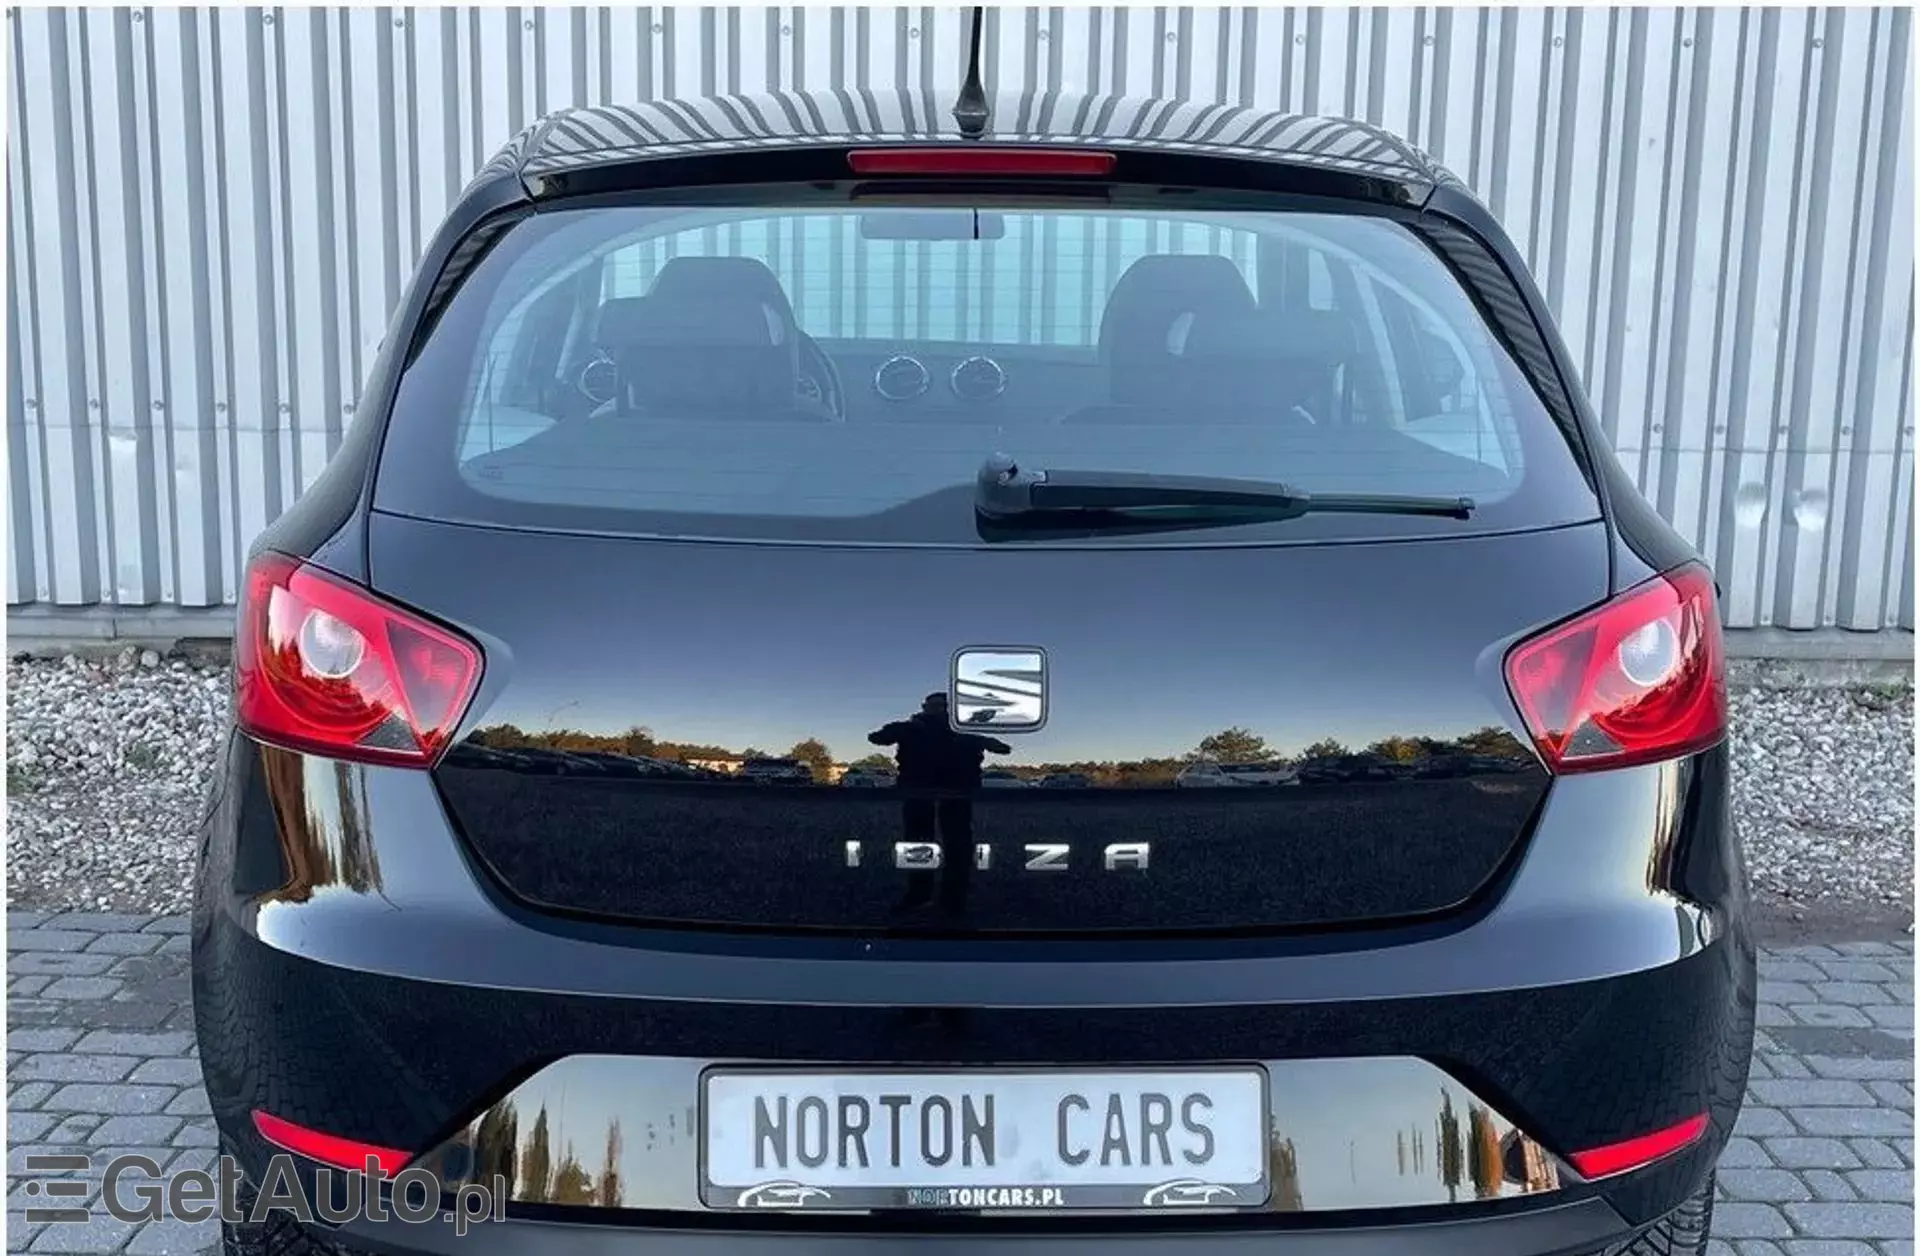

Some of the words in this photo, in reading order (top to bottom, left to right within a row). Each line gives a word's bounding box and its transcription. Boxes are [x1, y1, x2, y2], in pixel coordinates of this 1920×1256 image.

[845, 839, 1150, 872] IBIZA
[753, 1094, 996, 1169] NORTON
[1057, 1092, 1215, 1166] CARS
[906, 1187, 1065, 1208] NORTONCARS.PL
